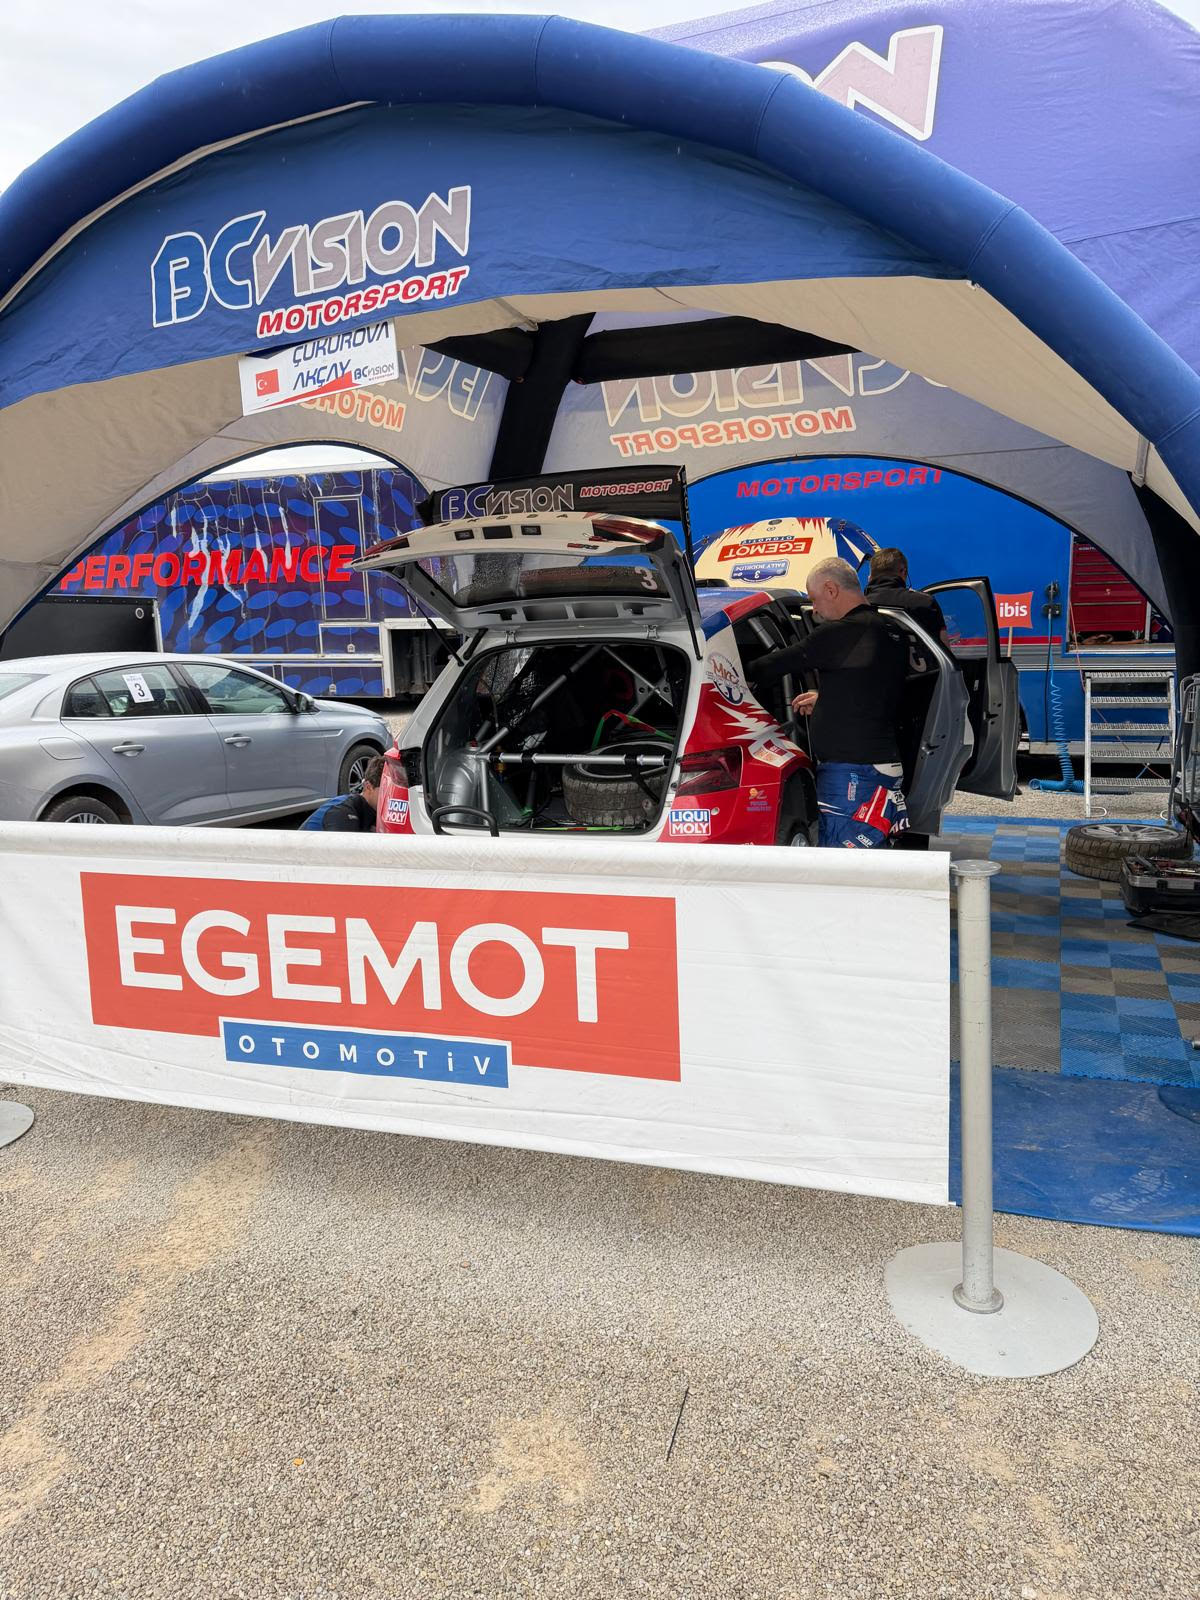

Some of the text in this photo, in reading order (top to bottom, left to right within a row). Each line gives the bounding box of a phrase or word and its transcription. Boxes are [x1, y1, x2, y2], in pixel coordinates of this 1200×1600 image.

[256, 266, 470, 339] MOTORSPORT
[293, 359, 352, 391] AKÇAY
[579, 479, 673, 498] MOTORSPORT
[736, 468, 943, 498] MOTORSPORT
[723, 542, 806, 558] EGEMOT
[60, 544, 356, 591] PERFORMANCE
[999, 602, 1028, 617] ibis
[134, 683, 145, 697] 3
[671, 811, 708, 823] LIQUI
[672, 822, 708, 834] MOLY
[115, 904, 630, 1024] EGEMOT
